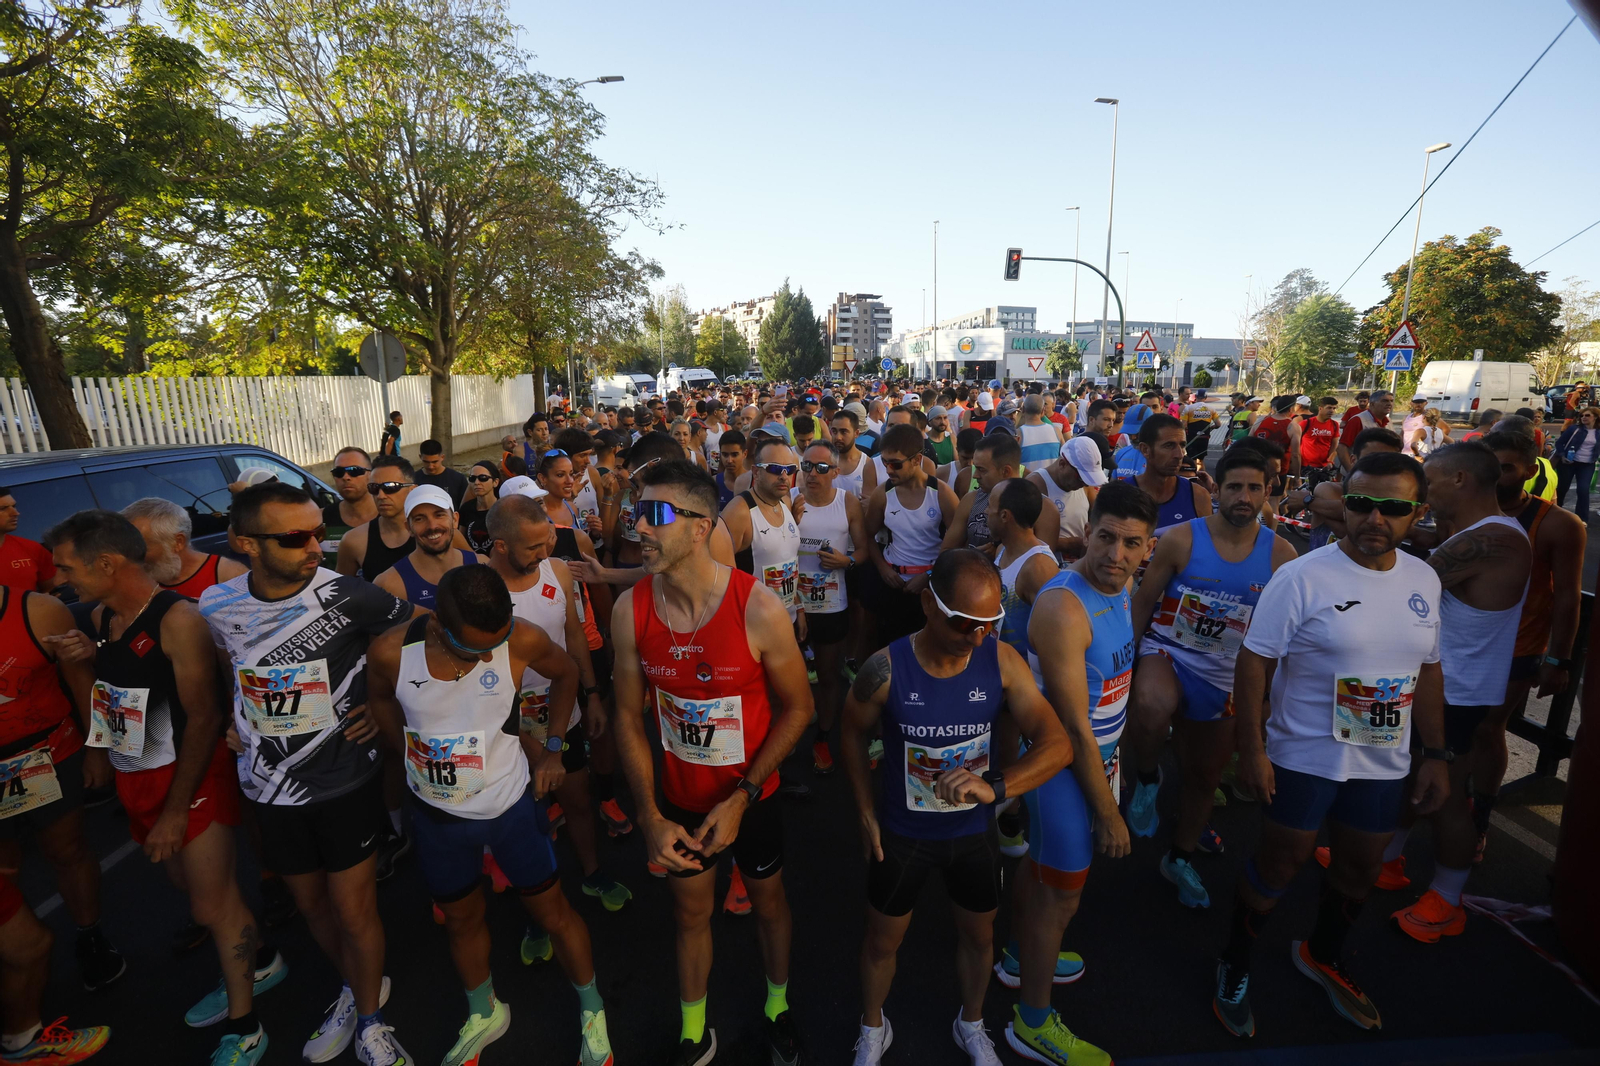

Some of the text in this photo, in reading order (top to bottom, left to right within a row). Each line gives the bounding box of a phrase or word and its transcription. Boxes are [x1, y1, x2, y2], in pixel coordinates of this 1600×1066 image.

[1012, 338, 1089, 351] MERCA
[11, 559, 31, 569] GTT
[781, 577, 794, 596] 116
[811, 587, 825, 601] 83
[327, 607, 343, 621] AL
[303, 613, 351, 652] VELETA
[1194, 616, 1227, 640] 132
[262, 689, 302, 717] 127
[1369, 701, 1401, 728] 95
[678, 721, 717, 748] 187
[899, 722, 991, 738] TROTASIERRA
[426, 760, 457, 786] 113
[1034, 1034, 1069, 1064] HOKA
